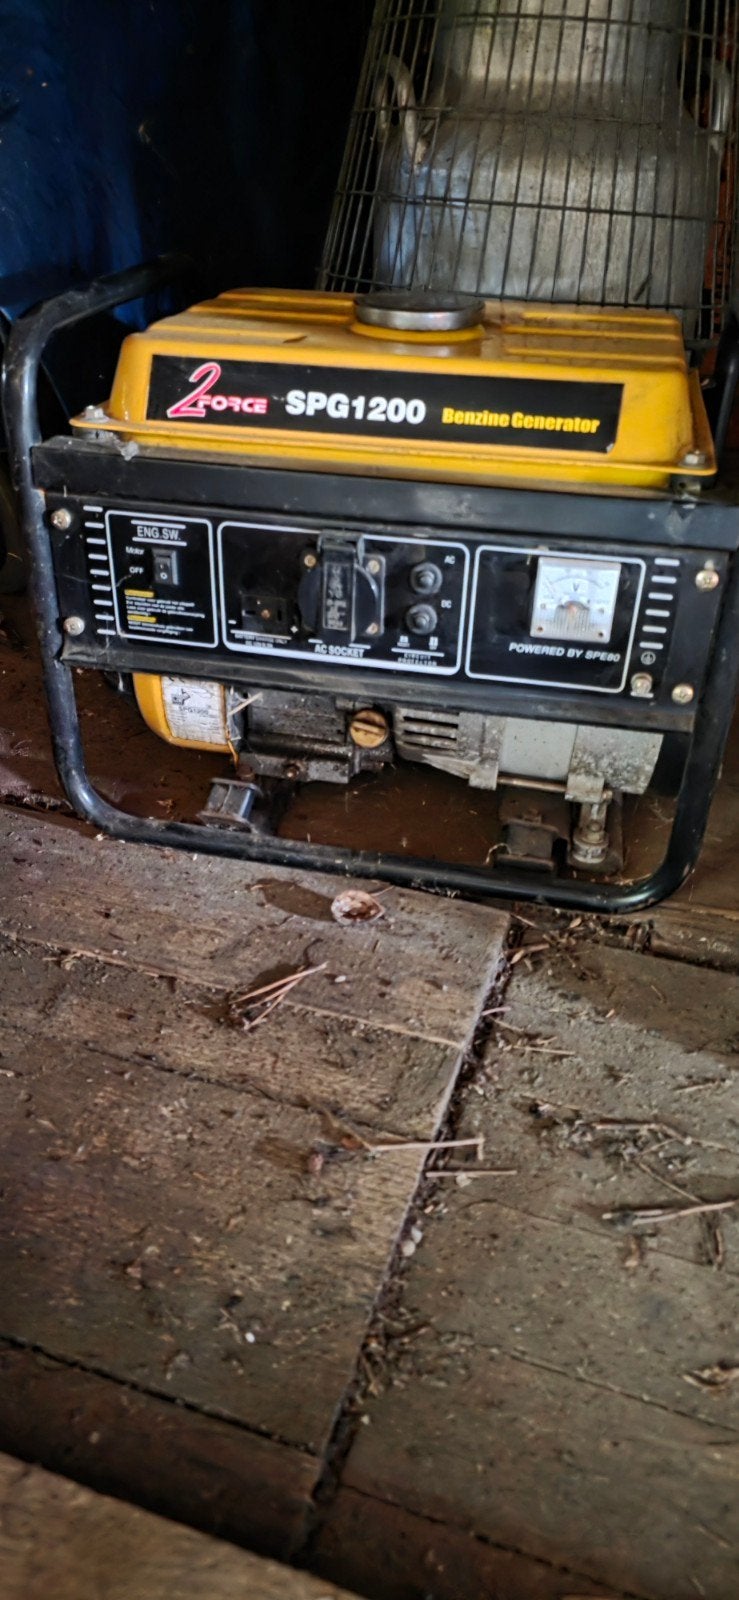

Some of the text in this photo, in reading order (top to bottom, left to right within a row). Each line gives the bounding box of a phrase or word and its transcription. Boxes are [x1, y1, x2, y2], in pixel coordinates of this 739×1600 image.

[196, 396, 269, 414] FORCE
[285, 390, 426, 424] SPG1200
[442, 407, 600, 435] Benzine Generator
[137, 526, 181, 541] ENG.SW.
[444, 555, 455, 564] AC
[315, 645, 364, 657] AC SOCKET
[509, 642, 565, 656] POWERED
[566, 647, 583, 659] BY
